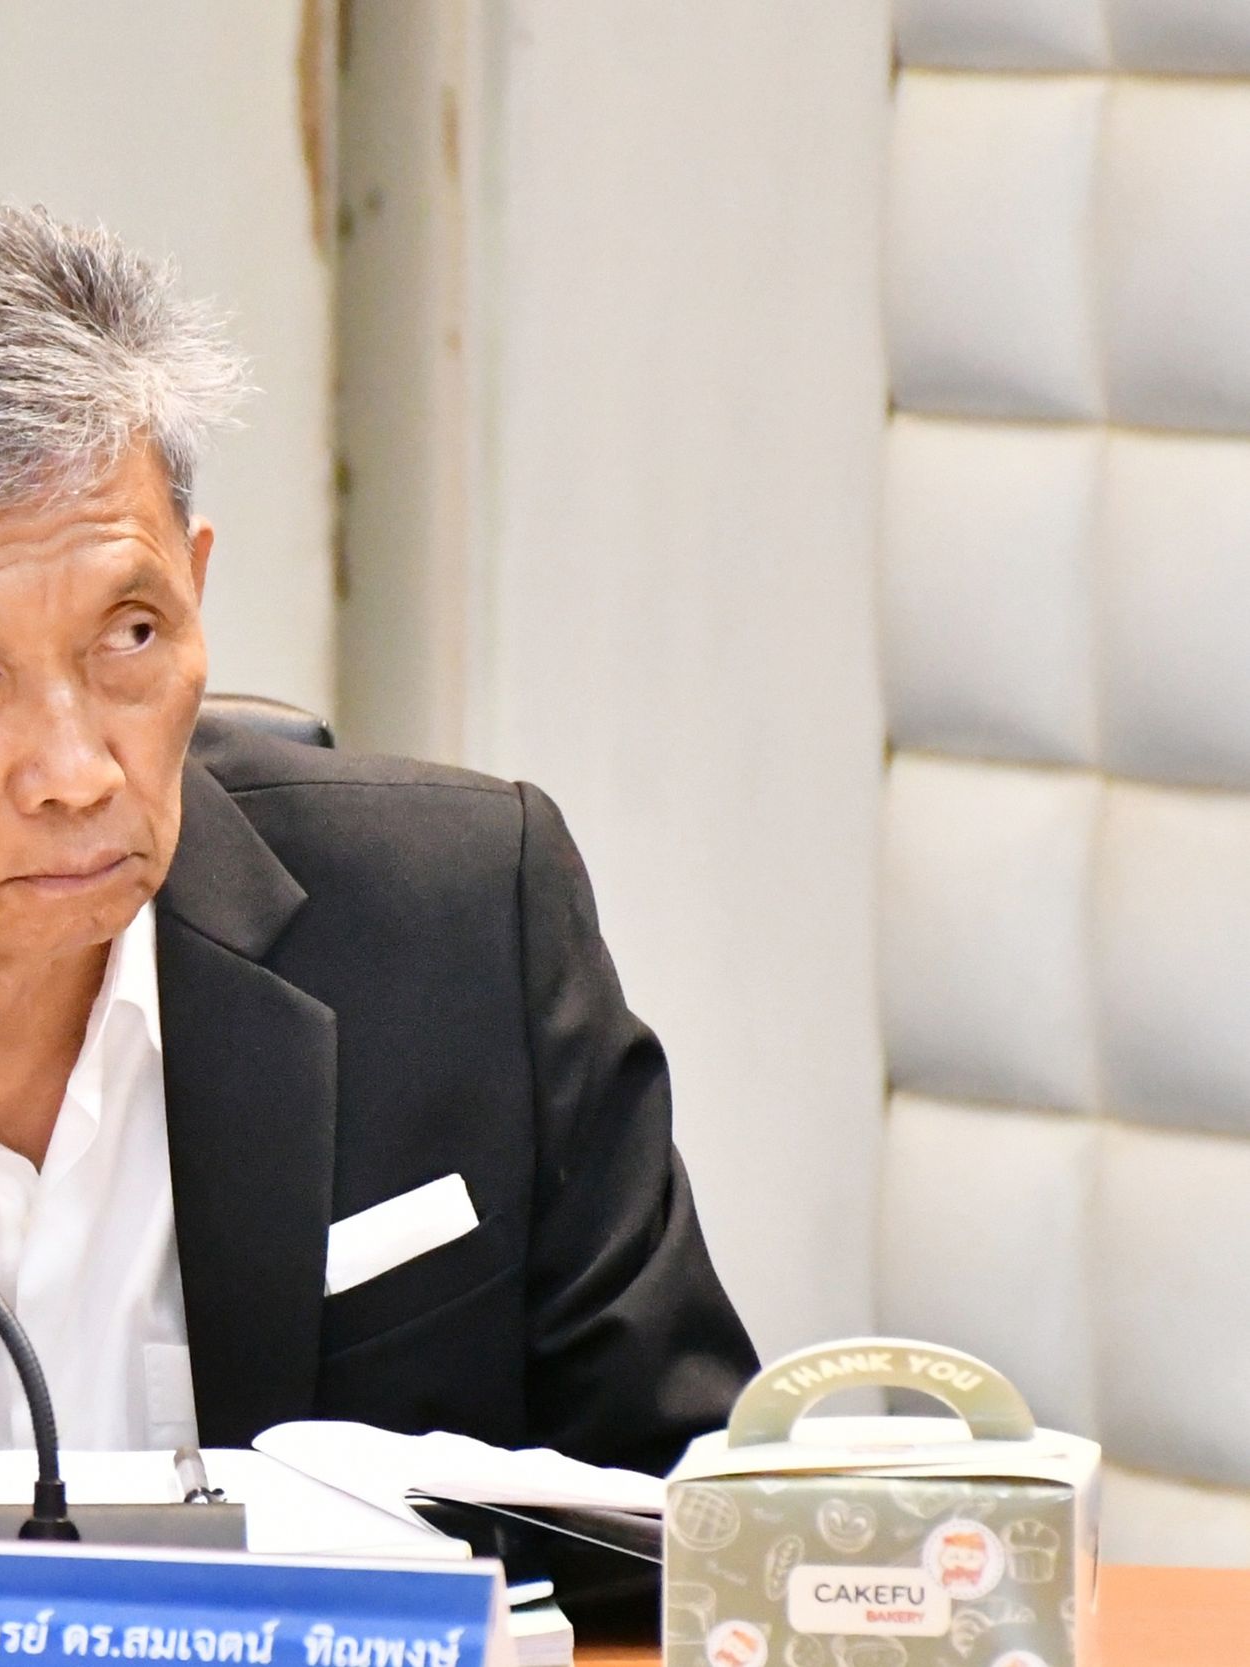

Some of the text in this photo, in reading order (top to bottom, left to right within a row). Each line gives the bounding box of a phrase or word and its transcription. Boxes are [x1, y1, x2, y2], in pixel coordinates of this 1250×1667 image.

[772, 1353, 983, 1396] THANK YOU
[813, 1583, 926, 1605] CAKEFU
[865, 1610, 926, 1624] BAKERY
[61, 1618, 281, 1665] ดร.สมเจตน์
